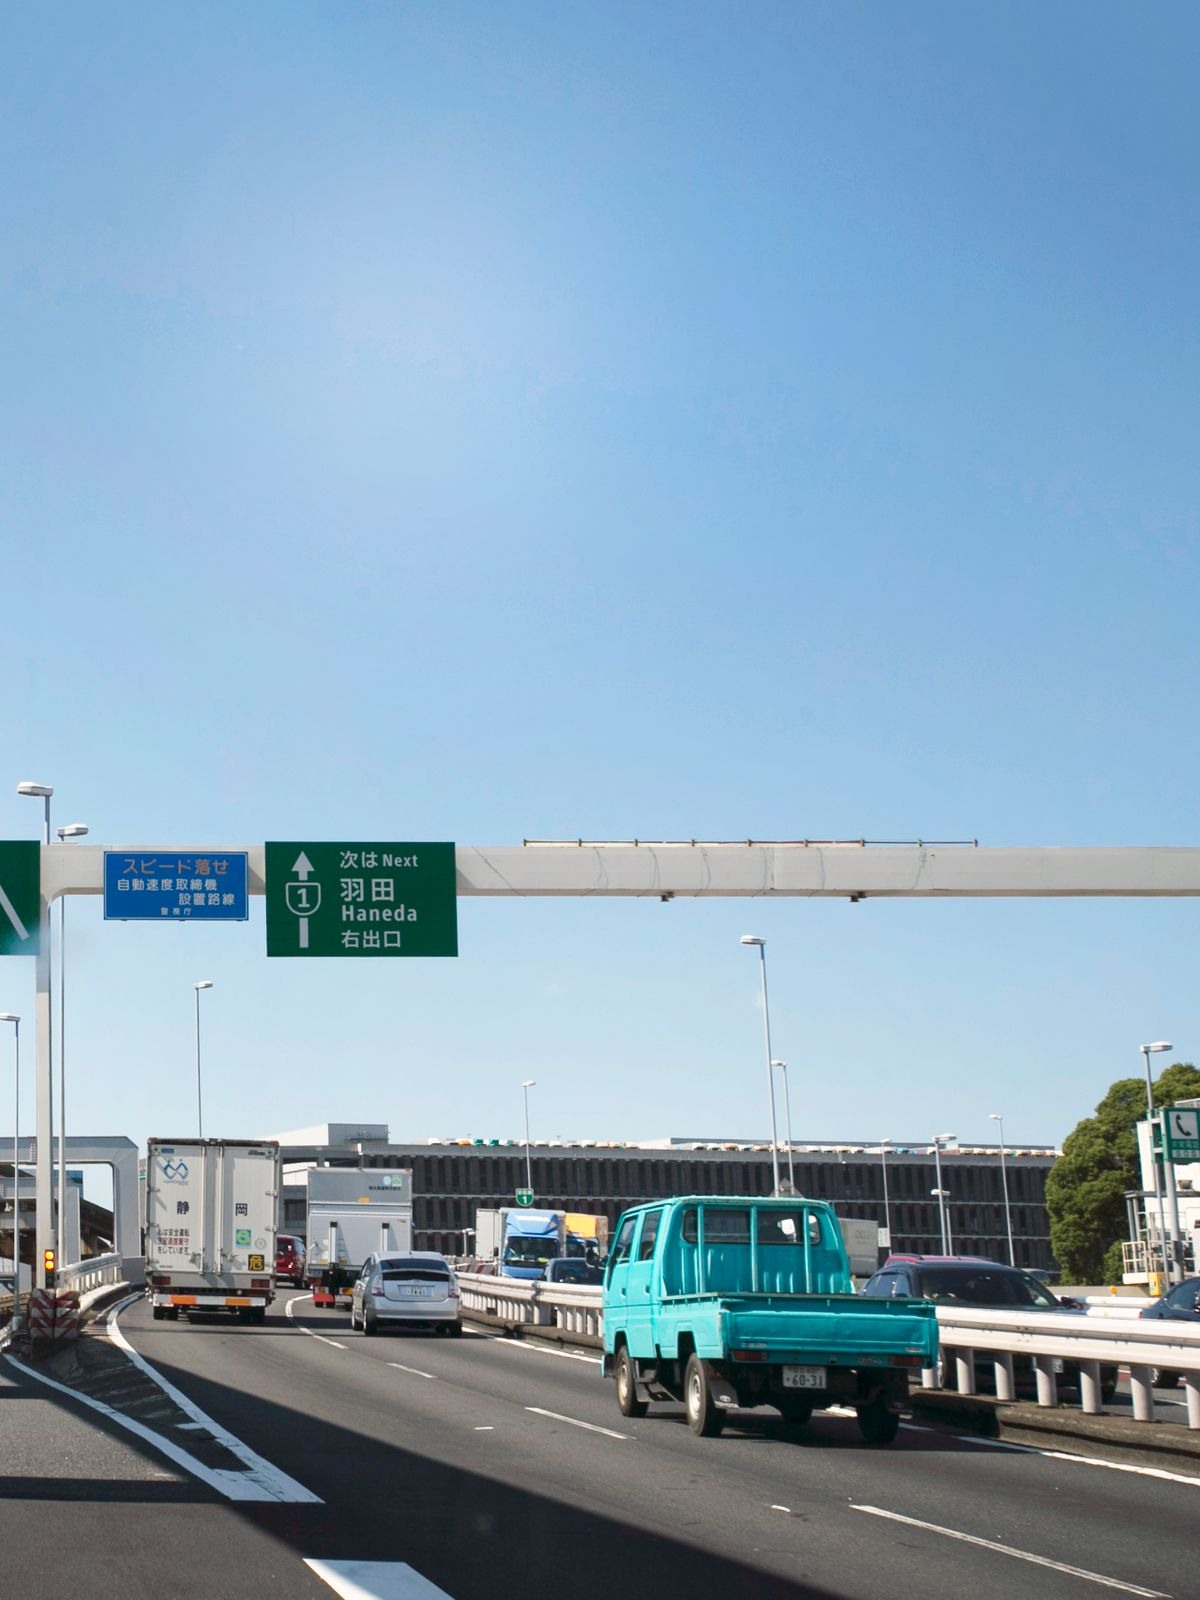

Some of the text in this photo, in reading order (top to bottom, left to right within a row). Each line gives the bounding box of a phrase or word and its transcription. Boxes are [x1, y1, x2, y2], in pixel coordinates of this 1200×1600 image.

[123, 859, 229, 875] スピード落せ
[339, 850, 419, 869] 次は Next
[117, 878, 218, 891] 自動速度取締機
[339, 878, 395, 902] 羽田
[178, 893, 235, 906] 設置路線
[296, 887, 311, 908] 1
[341, 904, 417, 922] Haneda
[341, 930, 401, 948] 右出口
[1175, 1150, 1197, 1158] SOS
[522, 1195, 528, 1204] 1
[249, 1255, 264, 1271] 危
[792, 1374, 823, 1388] 60-31
